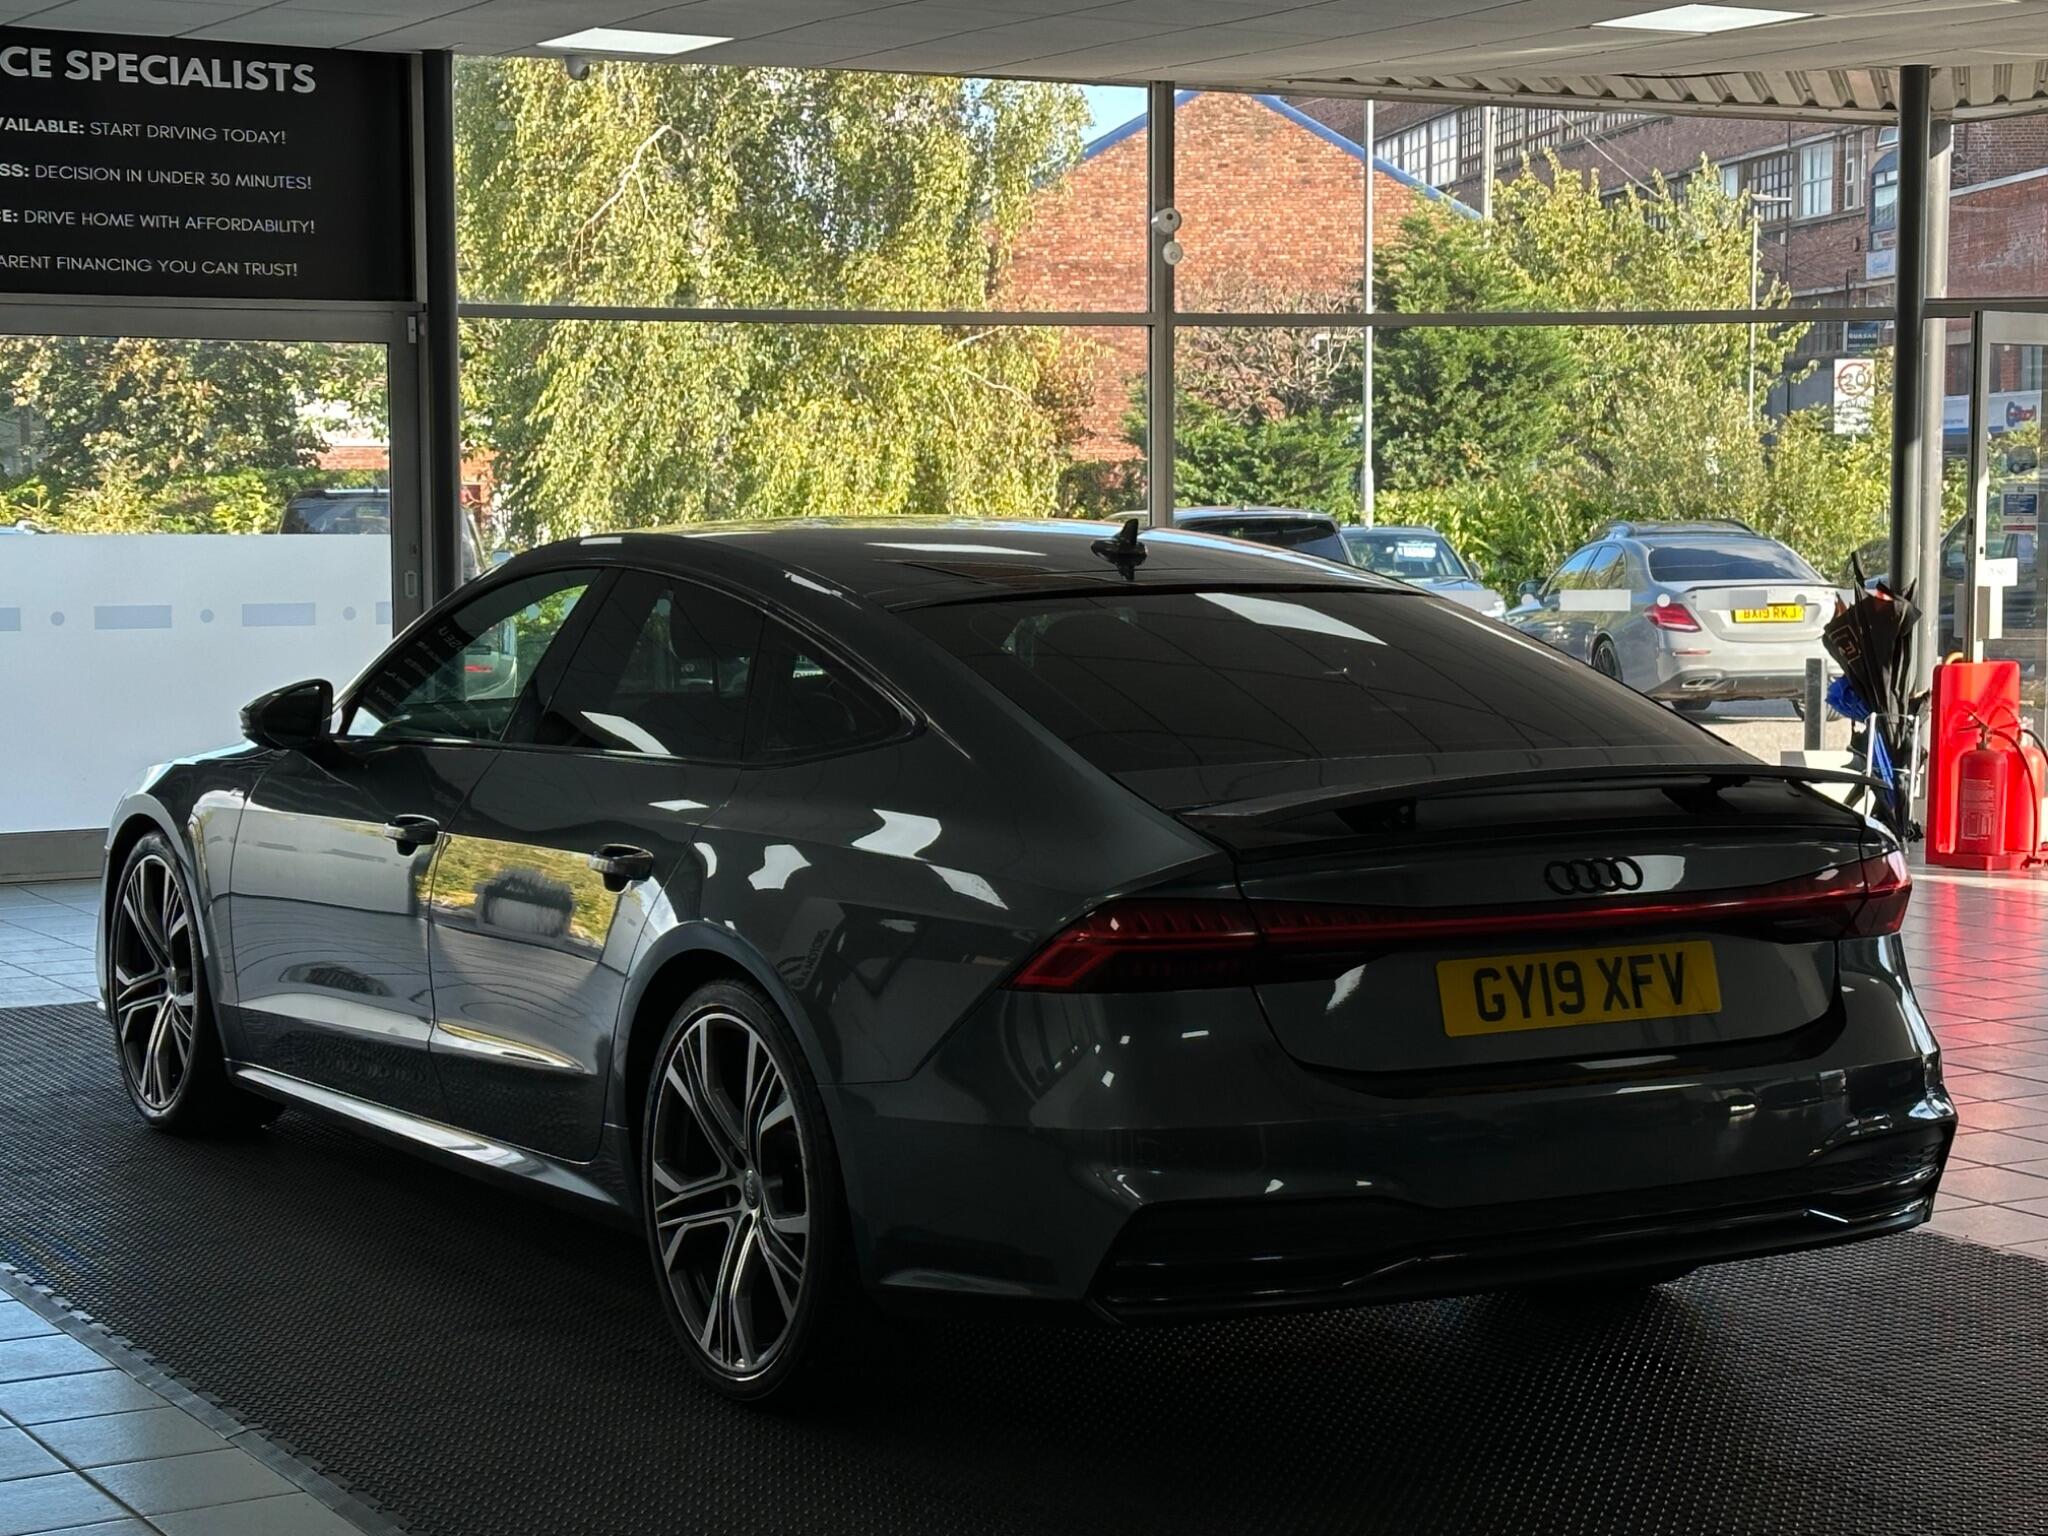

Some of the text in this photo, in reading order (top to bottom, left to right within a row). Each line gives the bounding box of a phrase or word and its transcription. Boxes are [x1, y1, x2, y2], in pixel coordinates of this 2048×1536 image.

[0, 46, 316, 93] CE SPECIALISTS
[90, 122, 141, 137] START
[147, 125, 217, 141] DRIVING
[222, 129, 286, 144] TODAY!
[0, 163, 312, 190] SS: DECISION IN UNDER 30 MINUTES!
[0, 209, 315, 234] E: DRIVE HOME WITH AFFORDABILITY!
[56, 256, 152, 272] FINANCING
[157, 260, 196, 273] YOU
[201, 261, 239, 275] CAN
[243, 262, 298, 277] TRUST!
[1473, 951, 1683, 1022] GY19 XFV
